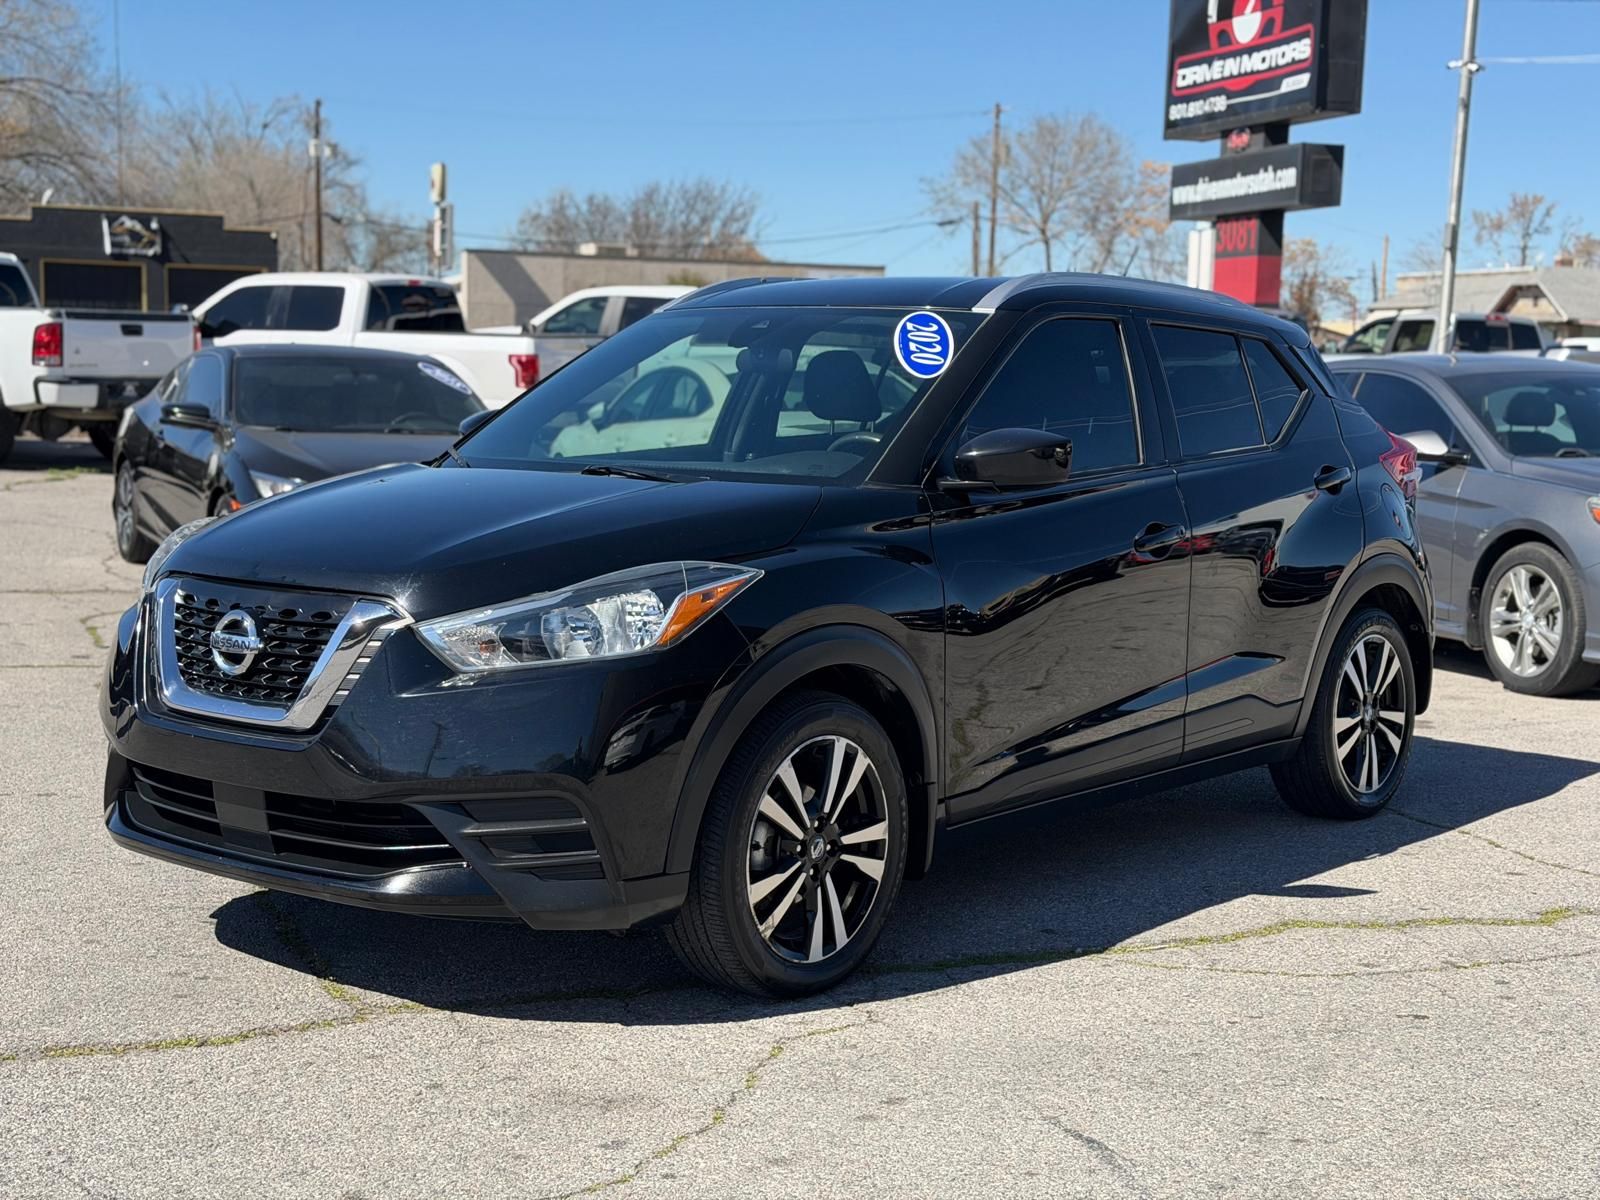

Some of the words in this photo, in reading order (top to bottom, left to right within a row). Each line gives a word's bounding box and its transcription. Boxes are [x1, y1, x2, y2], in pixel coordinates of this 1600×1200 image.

[1240, 38, 1311, 74] MOTORS
[1216, 218, 1257, 252] 3081
[906, 321, 945, 365] 2020
[212, 635, 251, 651] NISSAN
